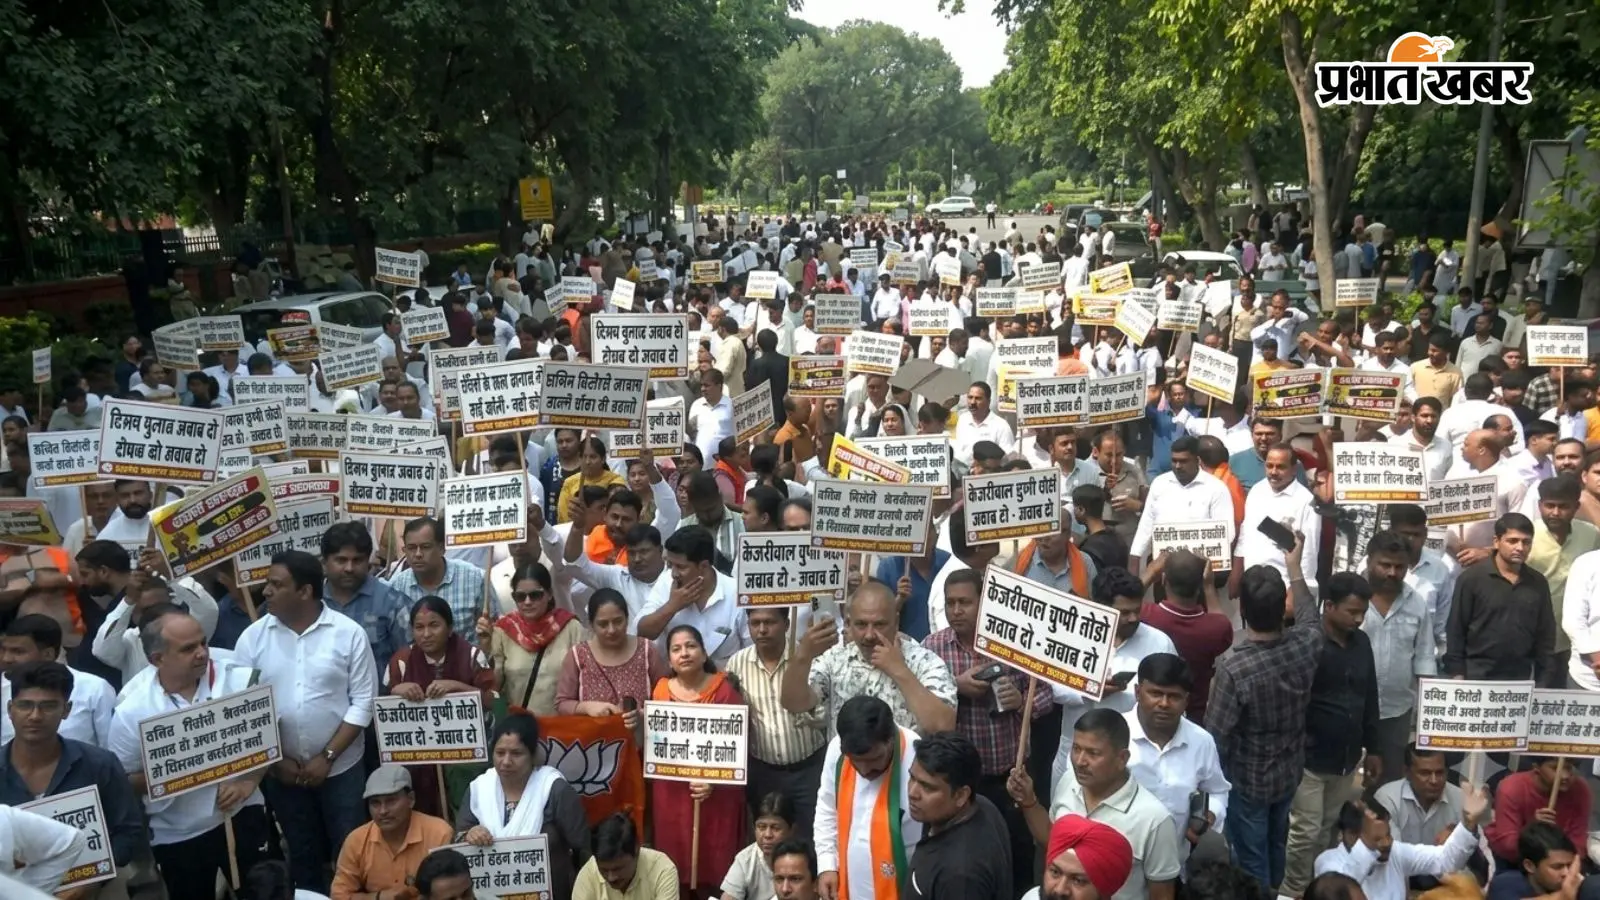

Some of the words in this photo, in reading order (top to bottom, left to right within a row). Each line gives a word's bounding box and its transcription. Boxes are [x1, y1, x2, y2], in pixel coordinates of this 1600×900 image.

[742, 540, 797, 562] केजरीवाल
[1020, 622, 1035, 650] दो
[1082, 646, 1100, 674] दो
[376, 702, 429, 723] केजरीवाल
